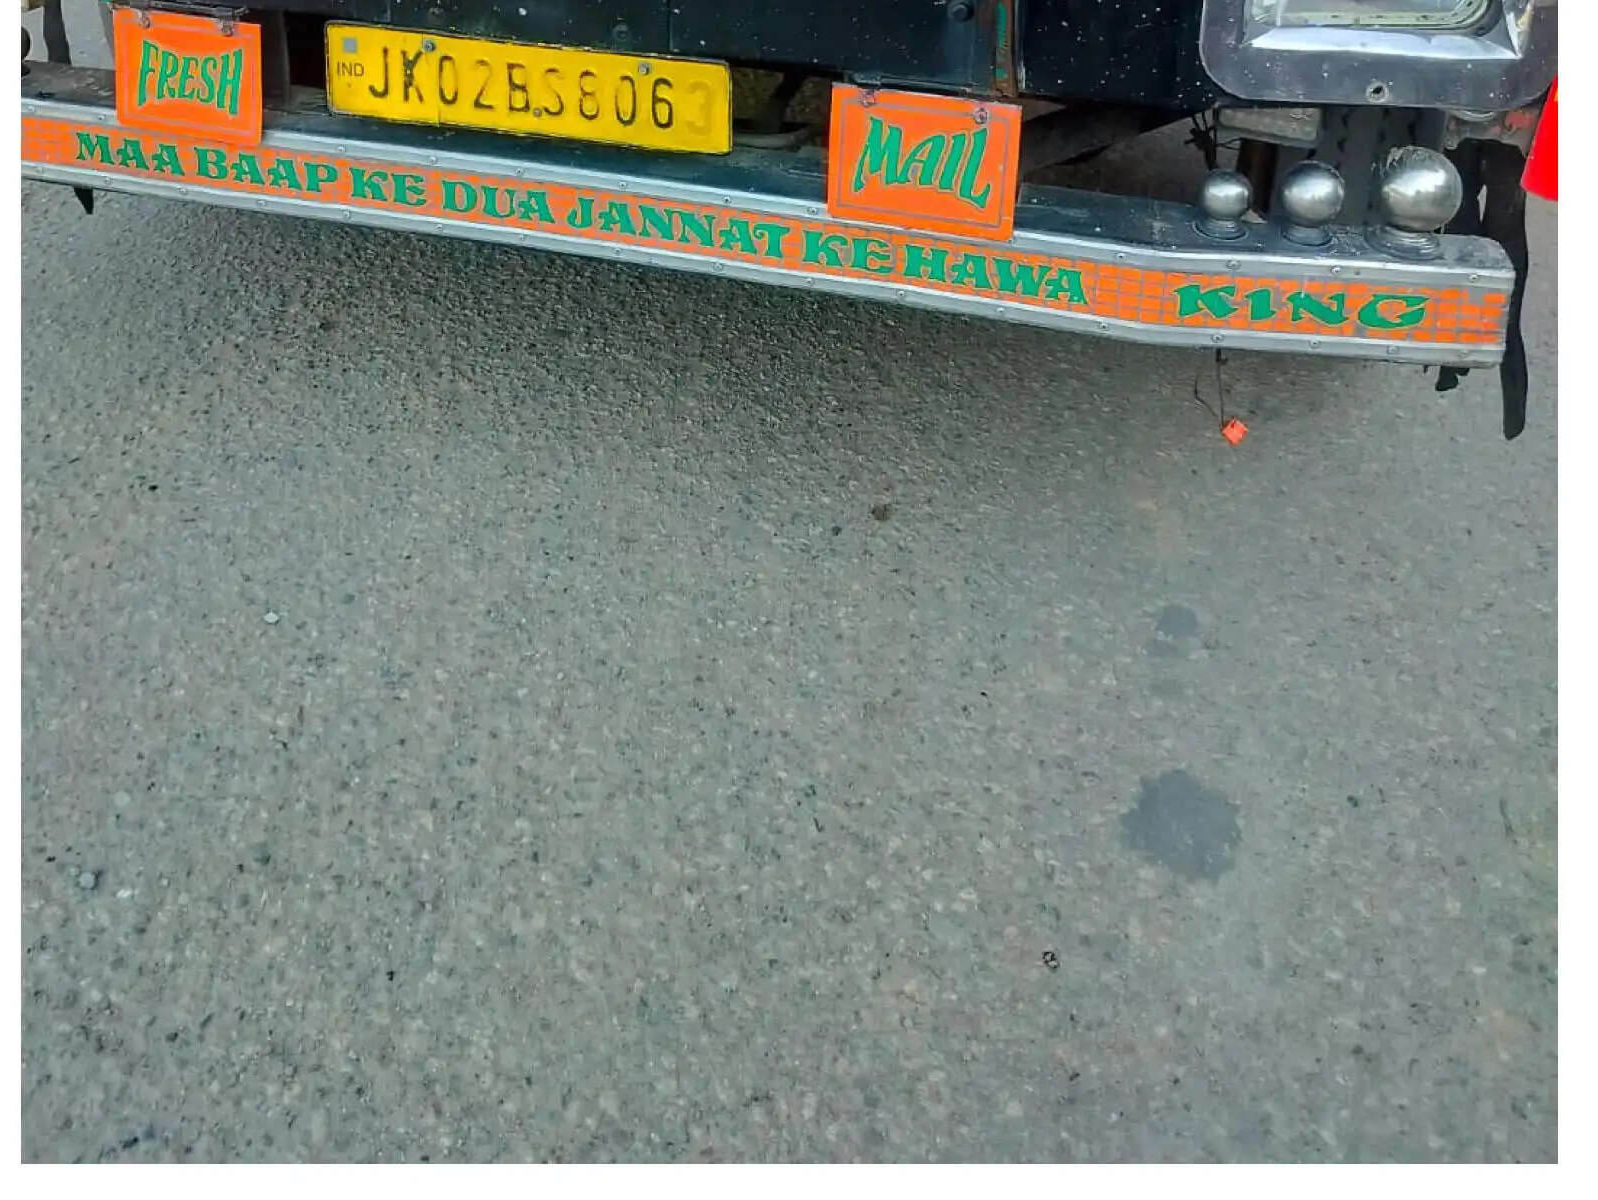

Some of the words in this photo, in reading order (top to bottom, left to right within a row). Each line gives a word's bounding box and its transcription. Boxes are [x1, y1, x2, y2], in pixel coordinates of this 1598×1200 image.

[137, 40, 244, 117] FRESH
[336, 60, 365, 78] IND
[851, 115, 992, 210] MAIL
[76, 131, 185, 177] MAA
[194, 146, 340, 194] BAAP
[349, 166, 427, 208] KE
[440, 179, 556, 224] DUA
[566, 195, 791, 260] JANNAT
[802, 229, 894, 277] KE
[902, 244, 1089, 307] HAWA
[1173, 282, 1430, 331] KING
